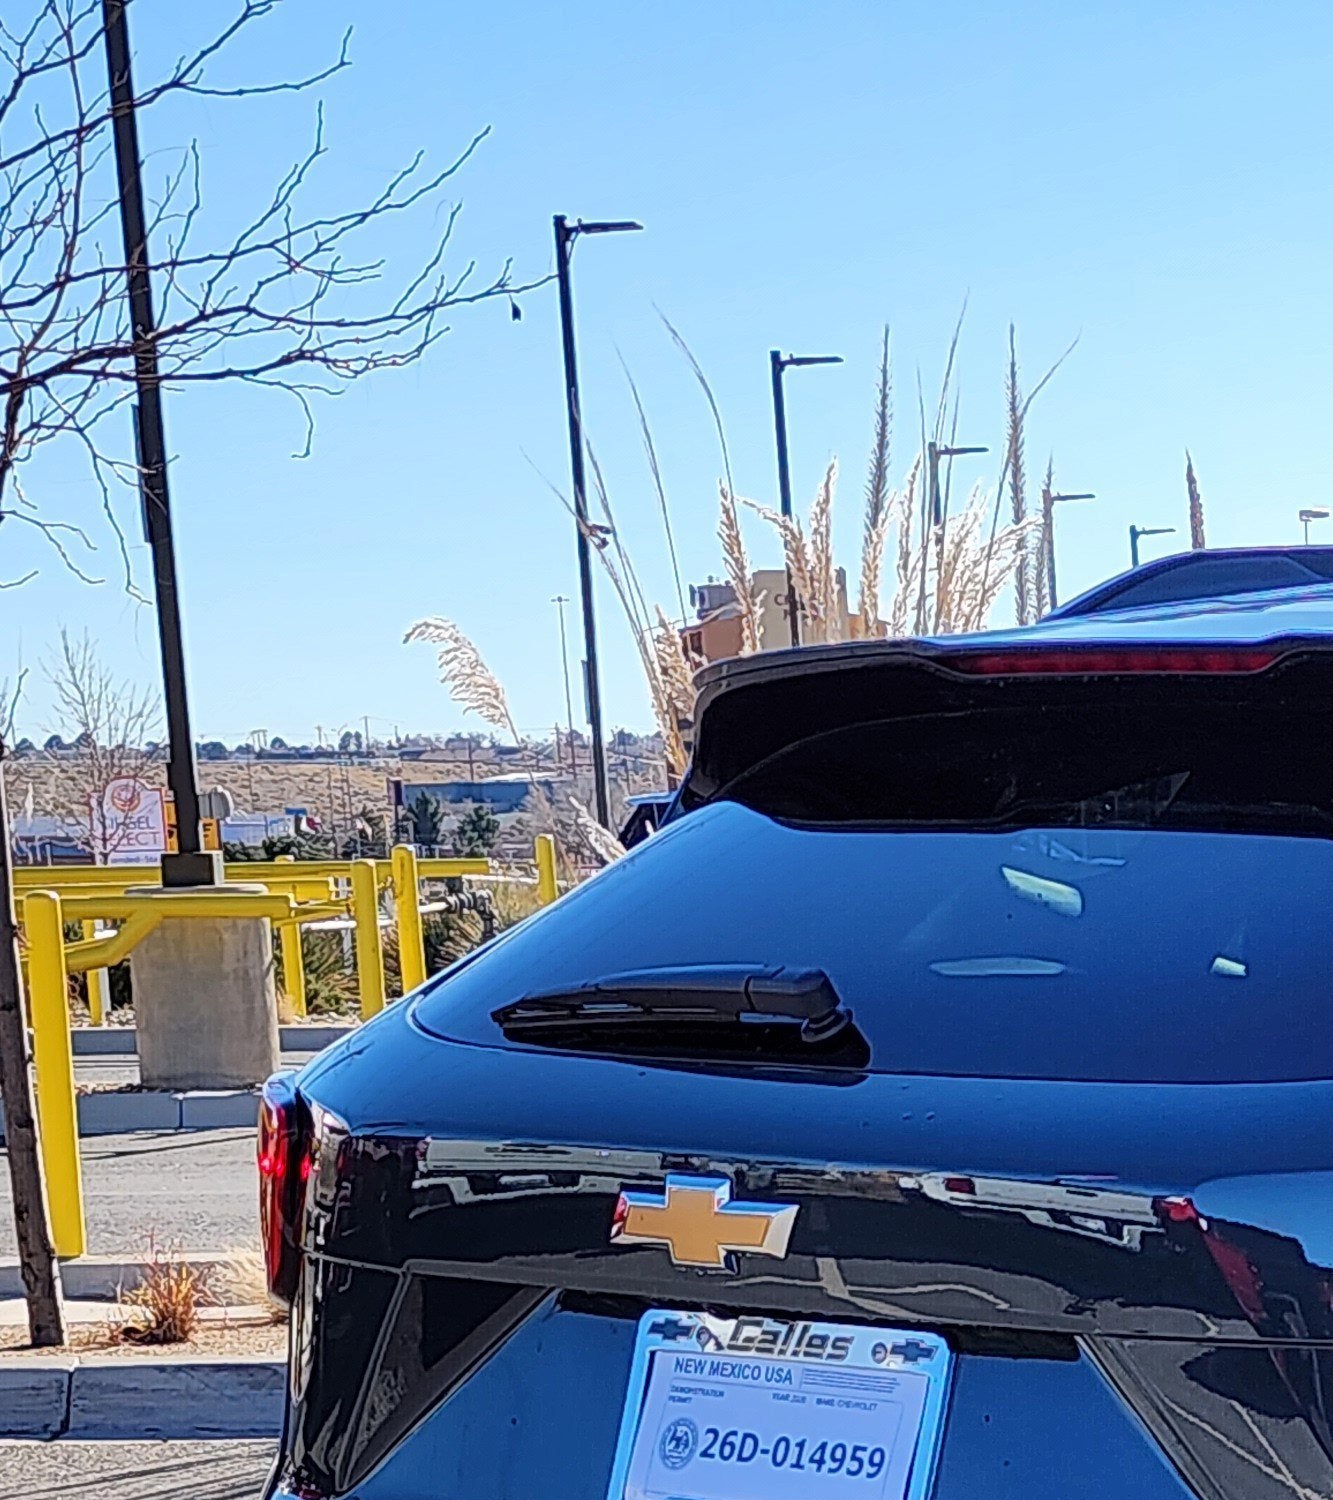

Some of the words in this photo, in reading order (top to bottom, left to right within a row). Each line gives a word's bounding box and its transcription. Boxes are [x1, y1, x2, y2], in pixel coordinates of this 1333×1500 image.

[727, 1315, 855, 1362] Galles
[674, 1357, 707, 1376] NEW
[708, 1360, 761, 1381] MEXICO
[764, 1365, 793, 1385] USA
[699, 1427, 886, 1479] 26D-014959
